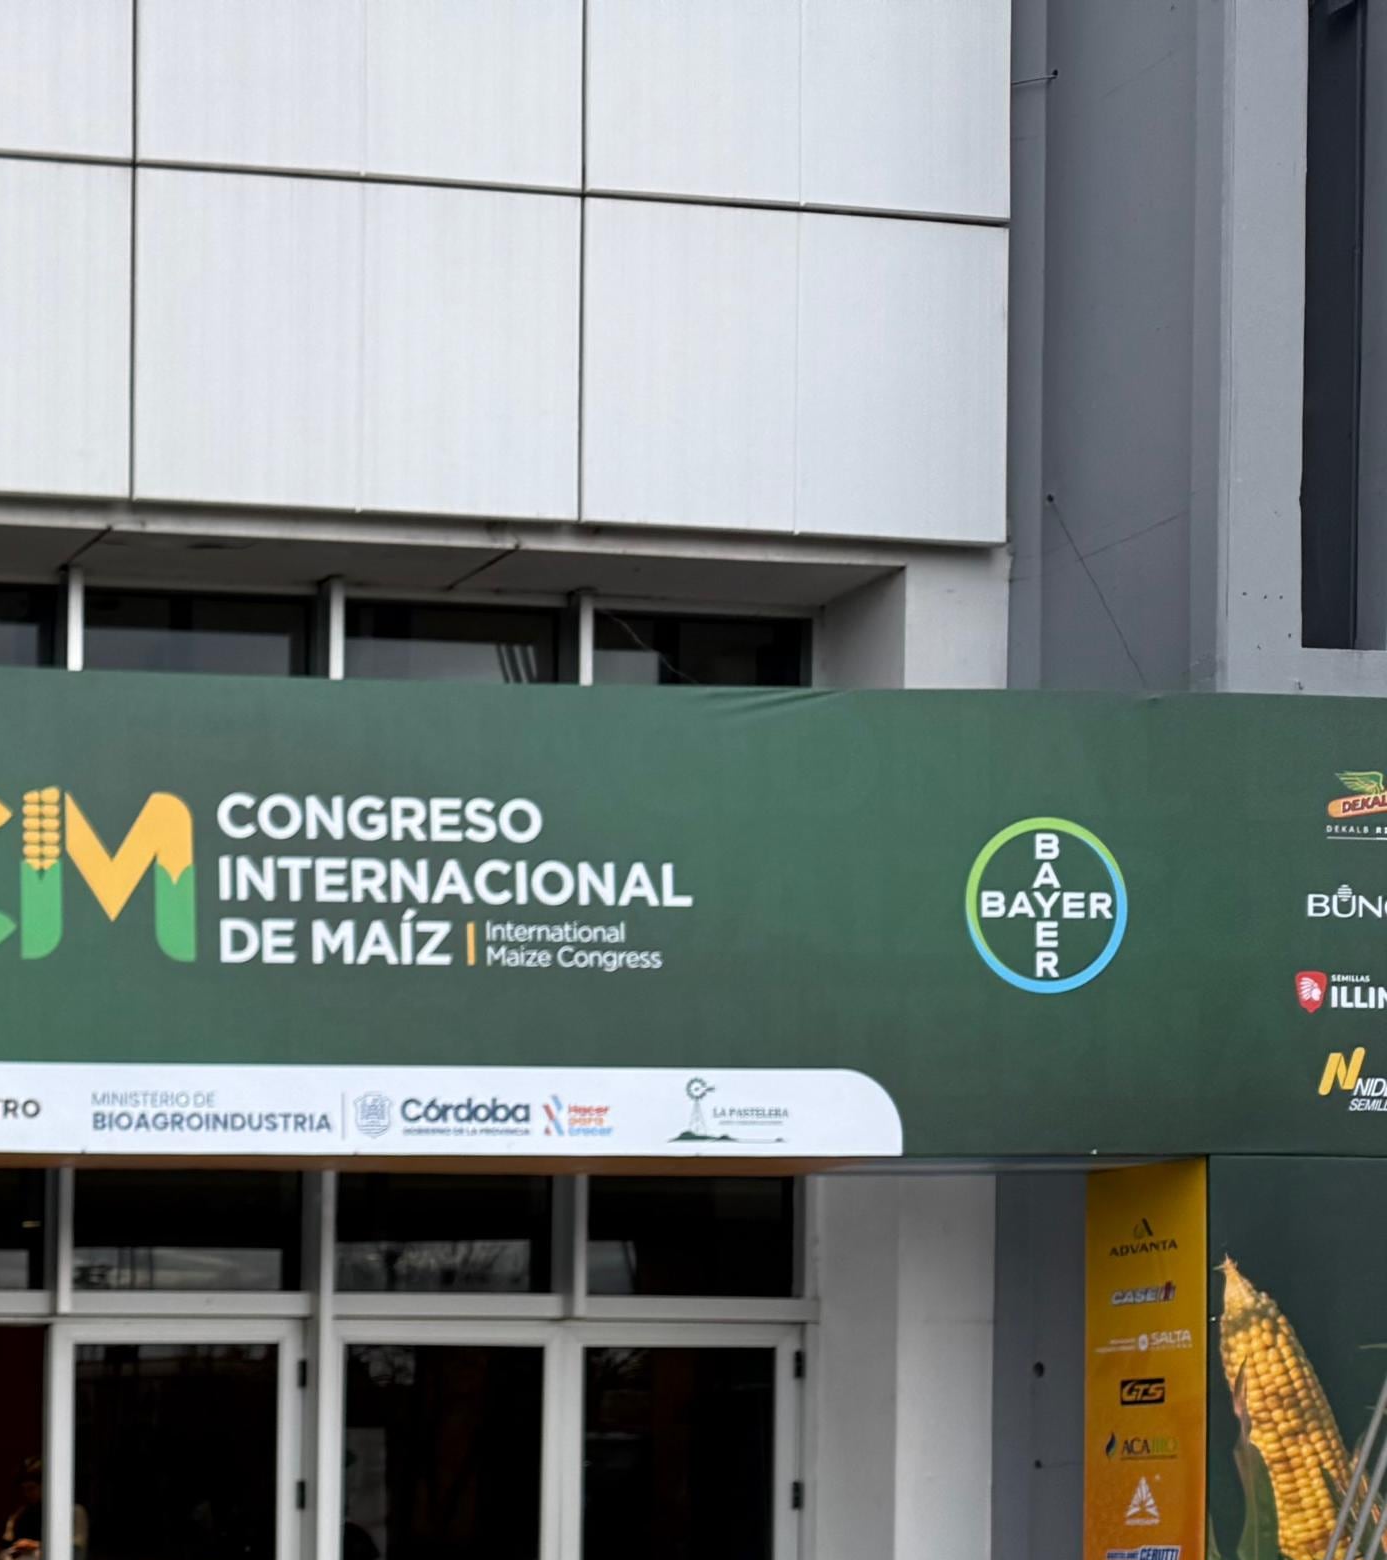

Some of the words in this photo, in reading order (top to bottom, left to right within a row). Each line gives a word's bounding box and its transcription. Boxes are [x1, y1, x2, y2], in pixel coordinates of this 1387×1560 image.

[217, 792, 543, 843] CONGRESO
[218, 855, 694, 907] INTERNACIONAL
[981, 891, 1113, 919] BAYER
[1032, 833, 1061, 978] BAYER
[1307, 894, 1387, 918] BUN
[219, 918, 297, 964] DE
[312, 909, 453, 965] MAÍZ
[485, 920, 626, 943] International
[485, 947, 552, 968] Maize
[557, 948, 663, 973] Congress
[1331, 974, 1370, 983] SEMILLAS
[91, 1091, 190, 1108] MINISTERIO
[194, 1091, 216, 1108] DE
[1353, 1077, 1387, 1097] NID
[400, 1096, 531, 1123] Córdoba
[713, 1107, 726, 1118] LA
[92, 1112, 332, 1133] BIOAGROINDUSTRIA
